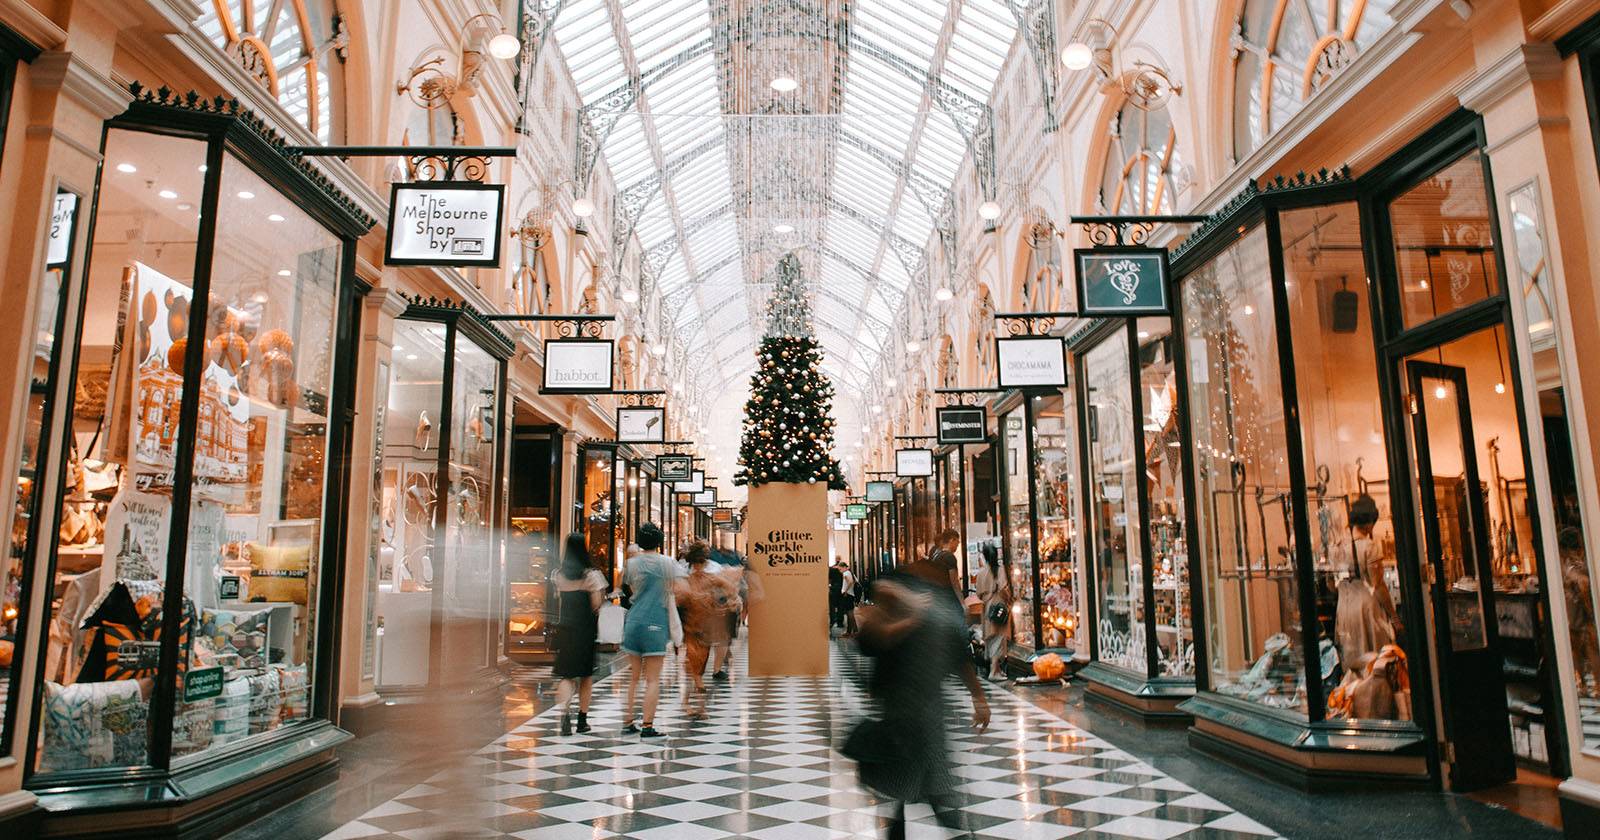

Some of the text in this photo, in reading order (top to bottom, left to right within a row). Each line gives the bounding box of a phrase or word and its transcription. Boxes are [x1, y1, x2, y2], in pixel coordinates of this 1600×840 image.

[420, 194, 447, 207] The
[403, 206, 488, 220] Melbourne
[416, 221, 456, 238] Shop
[430, 238, 449, 253] by
[768, 529, 813, 543] Glitter.
[754, 541, 803, 554] Sparkle
